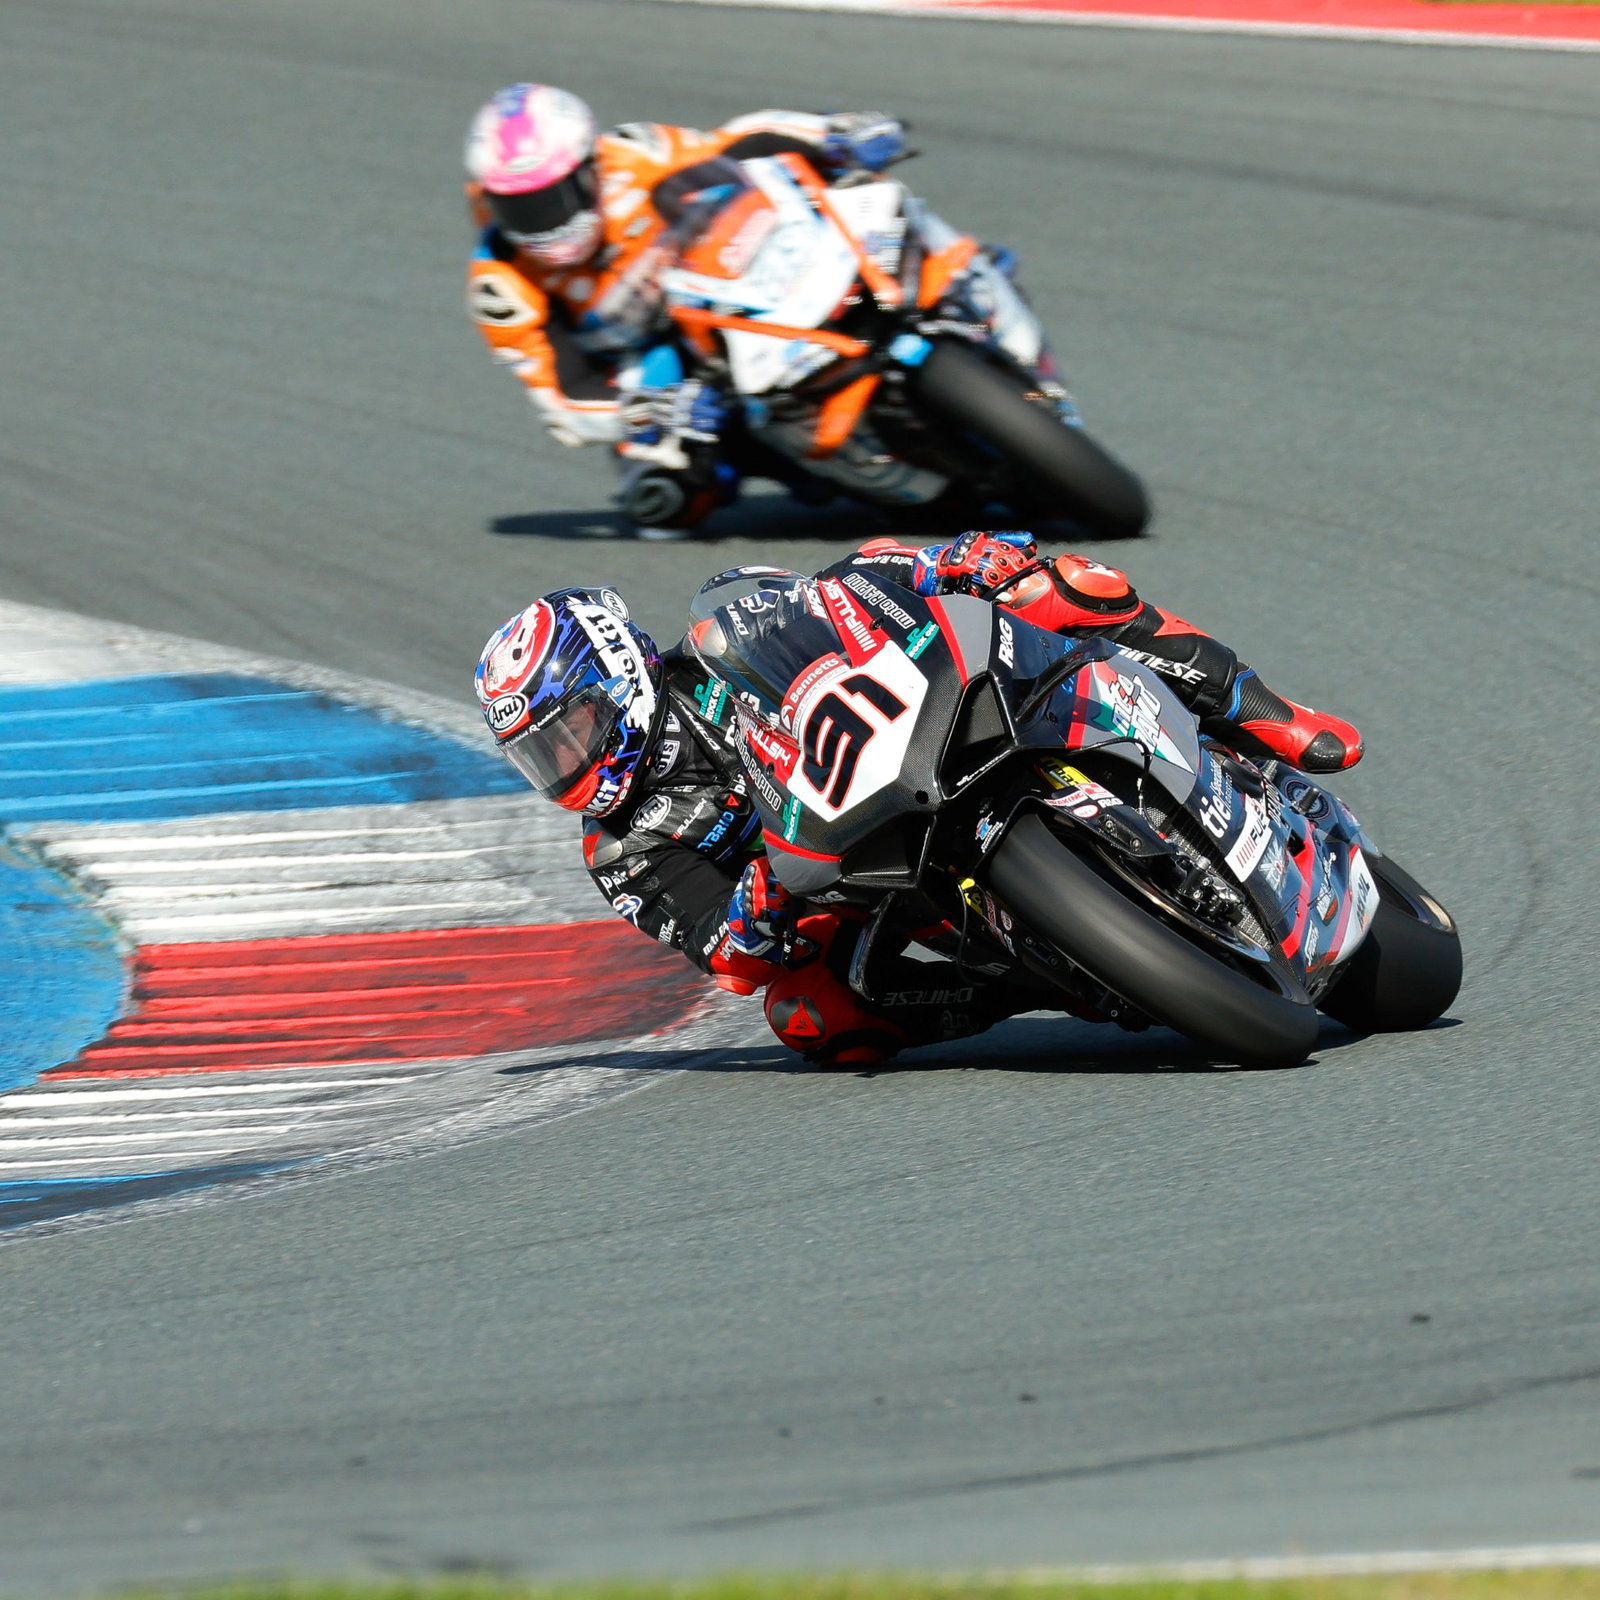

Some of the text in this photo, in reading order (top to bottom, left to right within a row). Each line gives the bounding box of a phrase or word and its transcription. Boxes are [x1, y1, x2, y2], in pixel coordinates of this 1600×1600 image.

[726, 603, 750, 636] DAIN
[842, 572, 917, 629] moto RAPIDO
[907, 623, 937, 658] ROCK OIL
[997, 617, 1014, 669] R&G
[789, 656, 840, 705] Bennetts
[490, 695, 519, 727] Arai
[704, 696, 718, 721] ROCK
[801, 673, 910, 811] 91
[578, 779, 620, 816] OKiT
[748, 757, 783, 812] RAPIDO
[696, 810, 735, 850] YBRID
[785, 814, 796, 841] ROCK
[1199, 795, 1231, 839] tie
